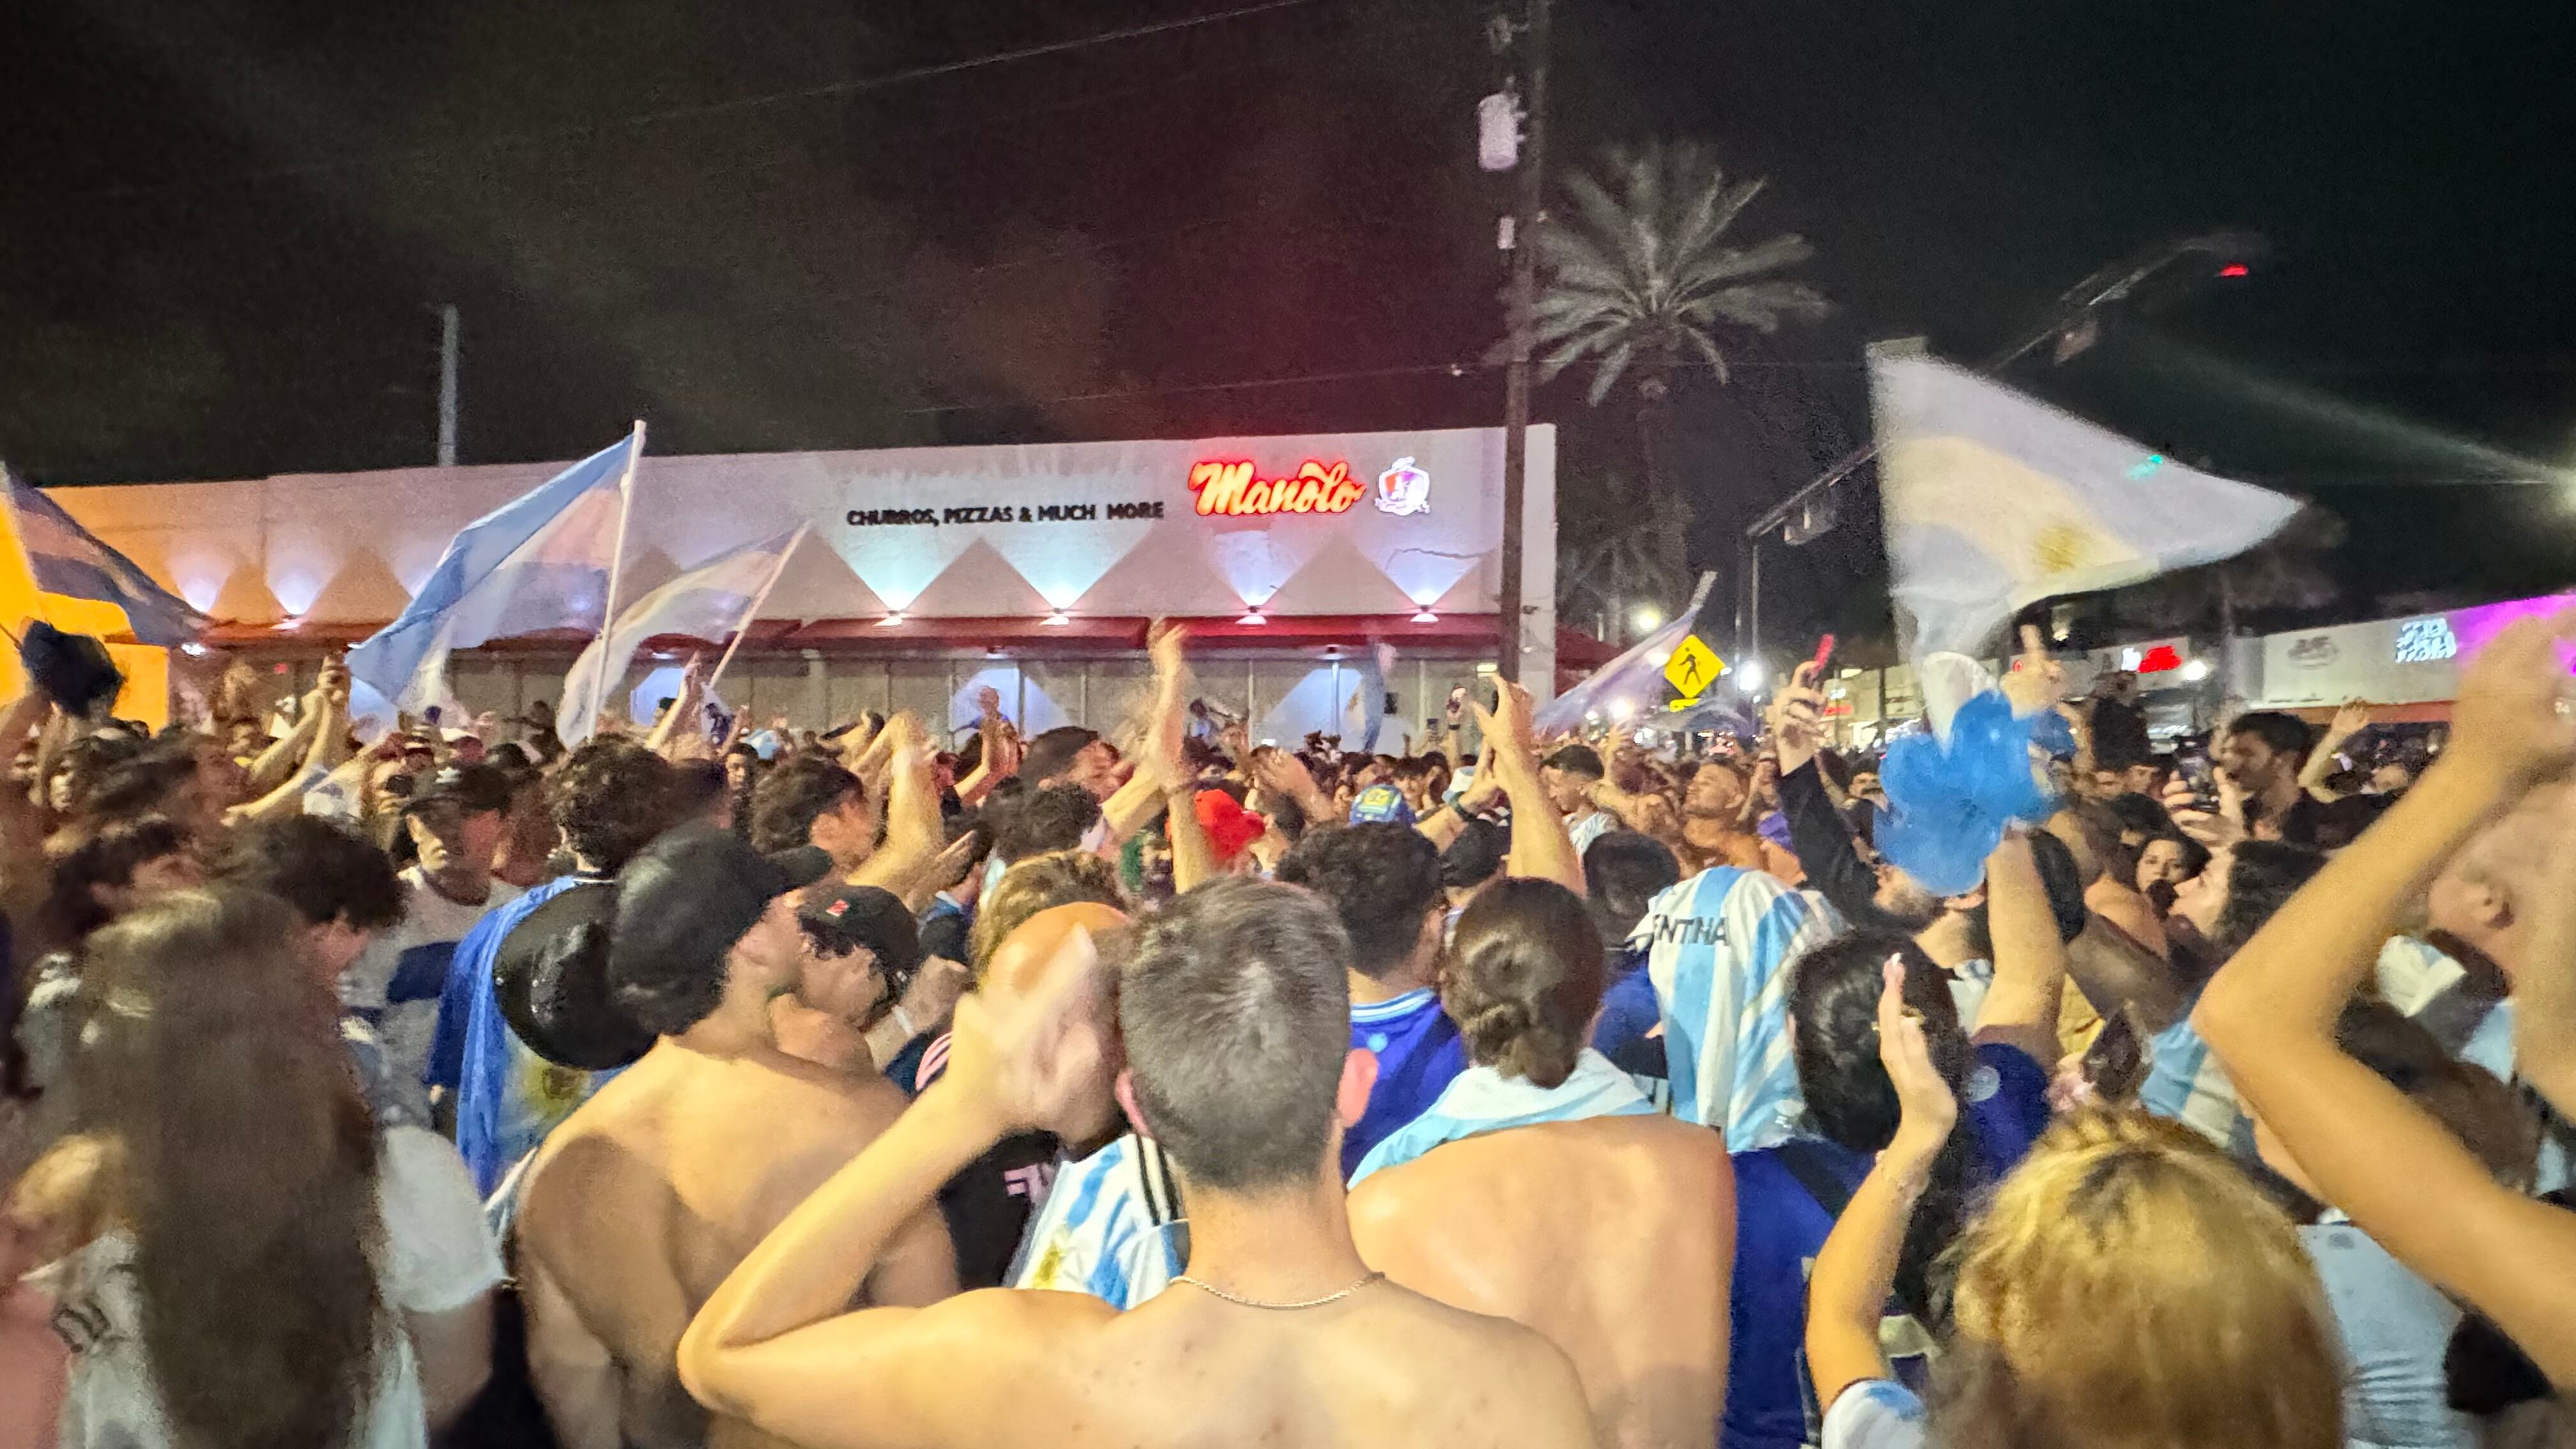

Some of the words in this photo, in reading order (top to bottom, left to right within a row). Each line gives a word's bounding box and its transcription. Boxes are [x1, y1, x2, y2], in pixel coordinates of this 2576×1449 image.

[1188, 460, 1367, 516] Manolo
[944, 507, 1013, 523] PIZZAS
[1018, 506, 1032, 523] &
[1038, 503, 1096, 521] MUCH
[1107, 502, 1164, 520] MORE
